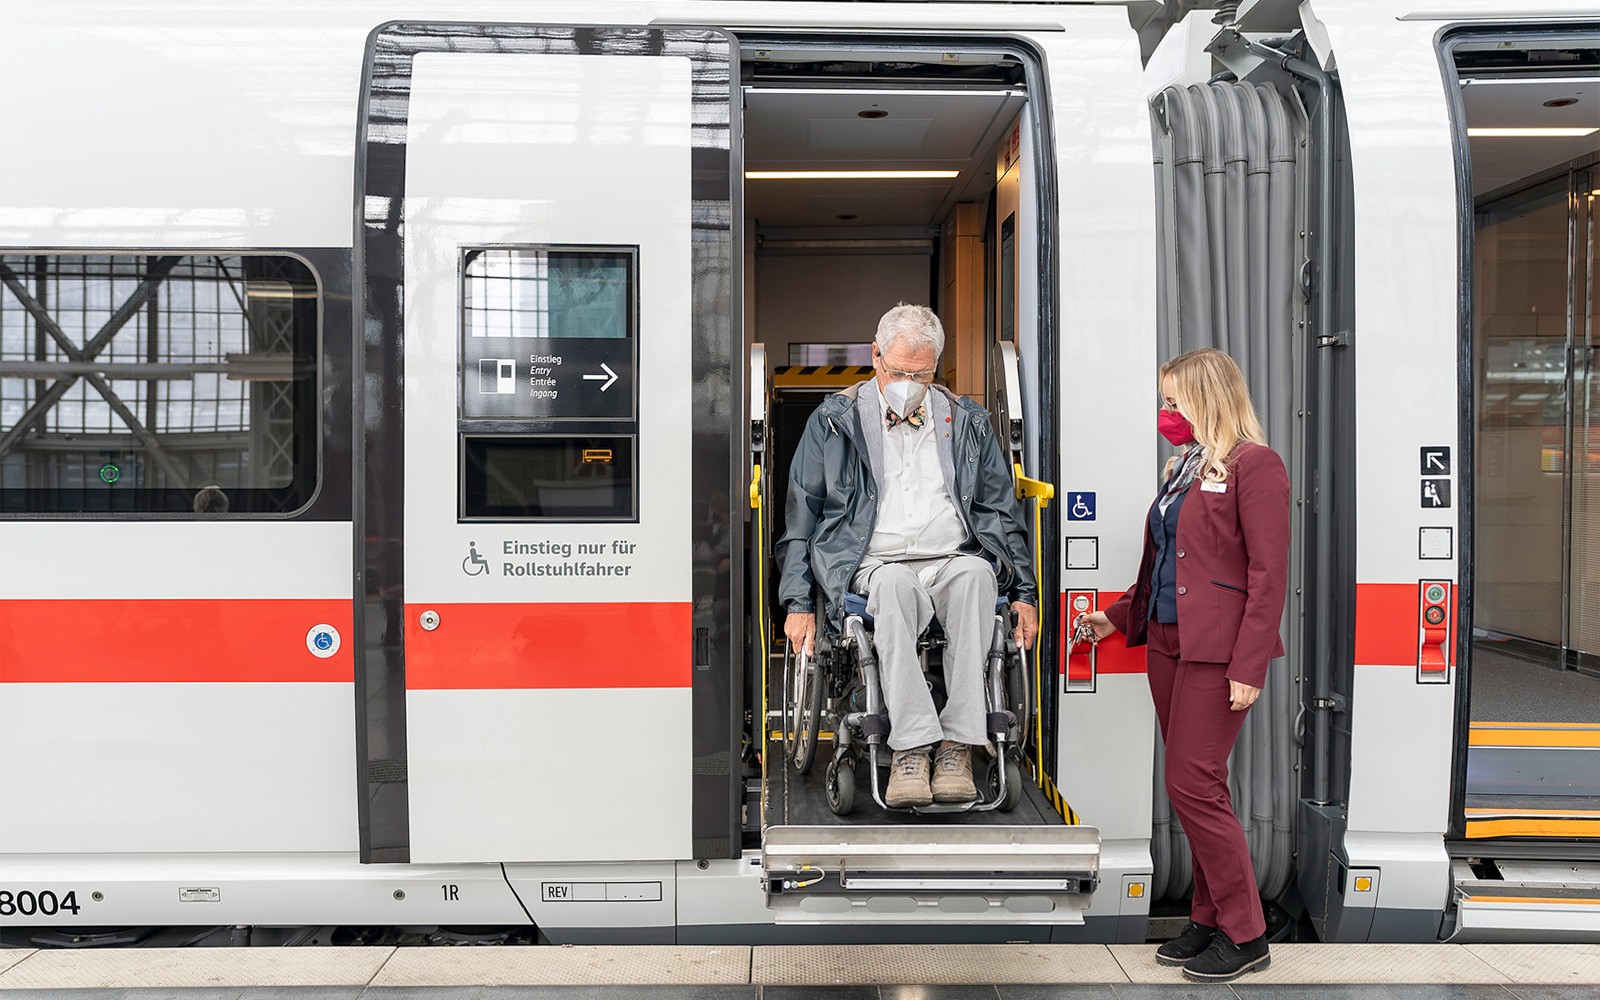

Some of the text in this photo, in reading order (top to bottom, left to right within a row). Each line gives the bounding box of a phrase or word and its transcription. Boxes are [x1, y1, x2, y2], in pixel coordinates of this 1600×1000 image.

[530, 354, 562, 366] Einstieg
[530, 366, 552, 376] Entry
[530, 377, 557, 386] Entrée
[530, 389, 558, 399] Ingang
[503, 540, 637, 558] Einstieg nur für
[503, 562, 632, 576] Rollstuhlfahrer
[441, 884, 460, 901] 1R
[548, 886, 568, 898] REV
[0, 890, 81, 916] 8004
